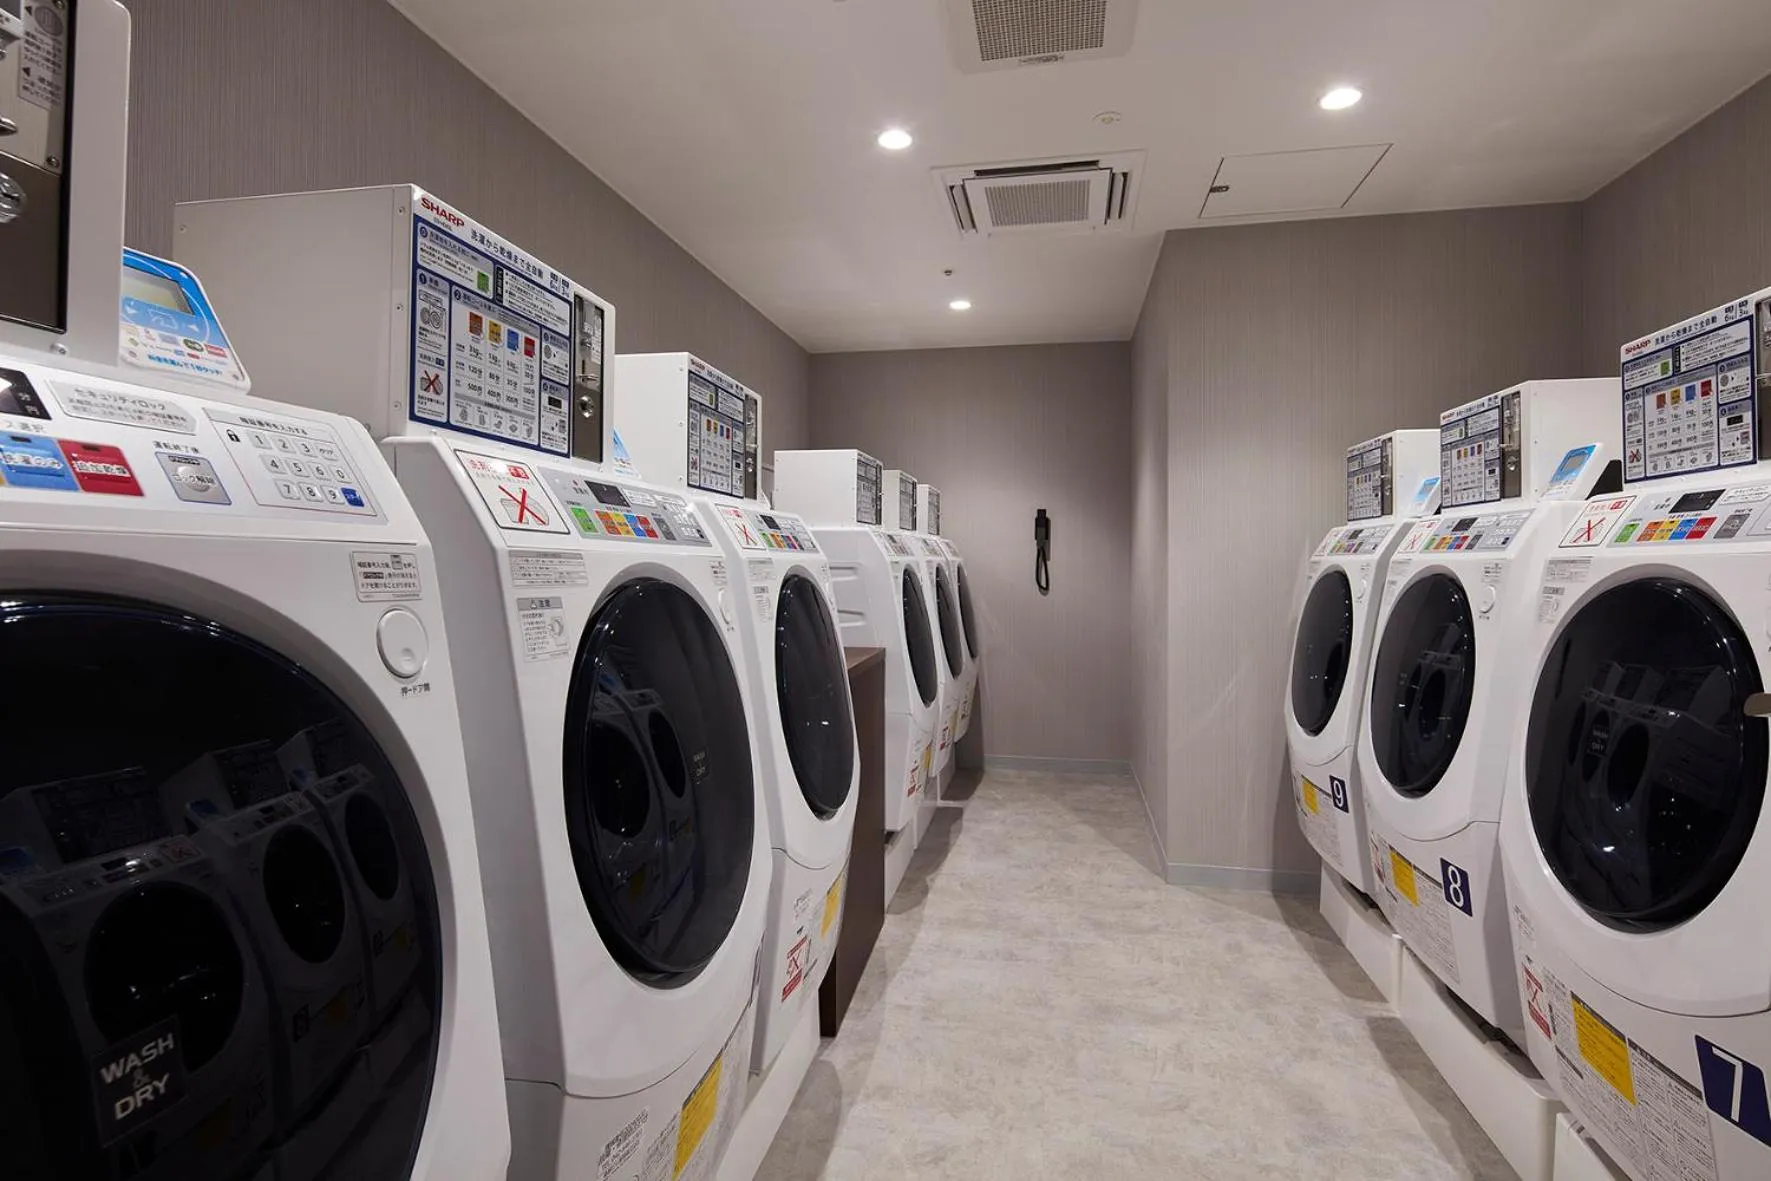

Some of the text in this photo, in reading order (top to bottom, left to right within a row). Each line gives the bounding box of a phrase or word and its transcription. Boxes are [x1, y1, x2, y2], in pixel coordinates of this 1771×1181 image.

[421, 197, 465, 227] SHARP
[1625, 340, 1652, 355] SHARP
[74, 388, 166, 410] セキュリティロック
[255, 435, 264, 445] 1
[278, 439, 289, 449] 2
[301, 443, 310, 453] 3
[270, 459, 279, 470] 4
[292, 462, 302, 473] 5
[315, 466, 324, 476] 6
[336, 469, 345, 479] 0
[283, 484, 291, 494] 7
[306, 487, 315, 497] 8
[328, 490, 337, 500] 9
[1332, 779, 1345, 809] 9
[1448, 865, 1465, 909] 8
[100, 1032, 175, 1085] WASH
[132, 1068, 152, 1089] &
[1711, 1045, 1744, 1123] 7
[115, 1072, 170, 1121] DRY
